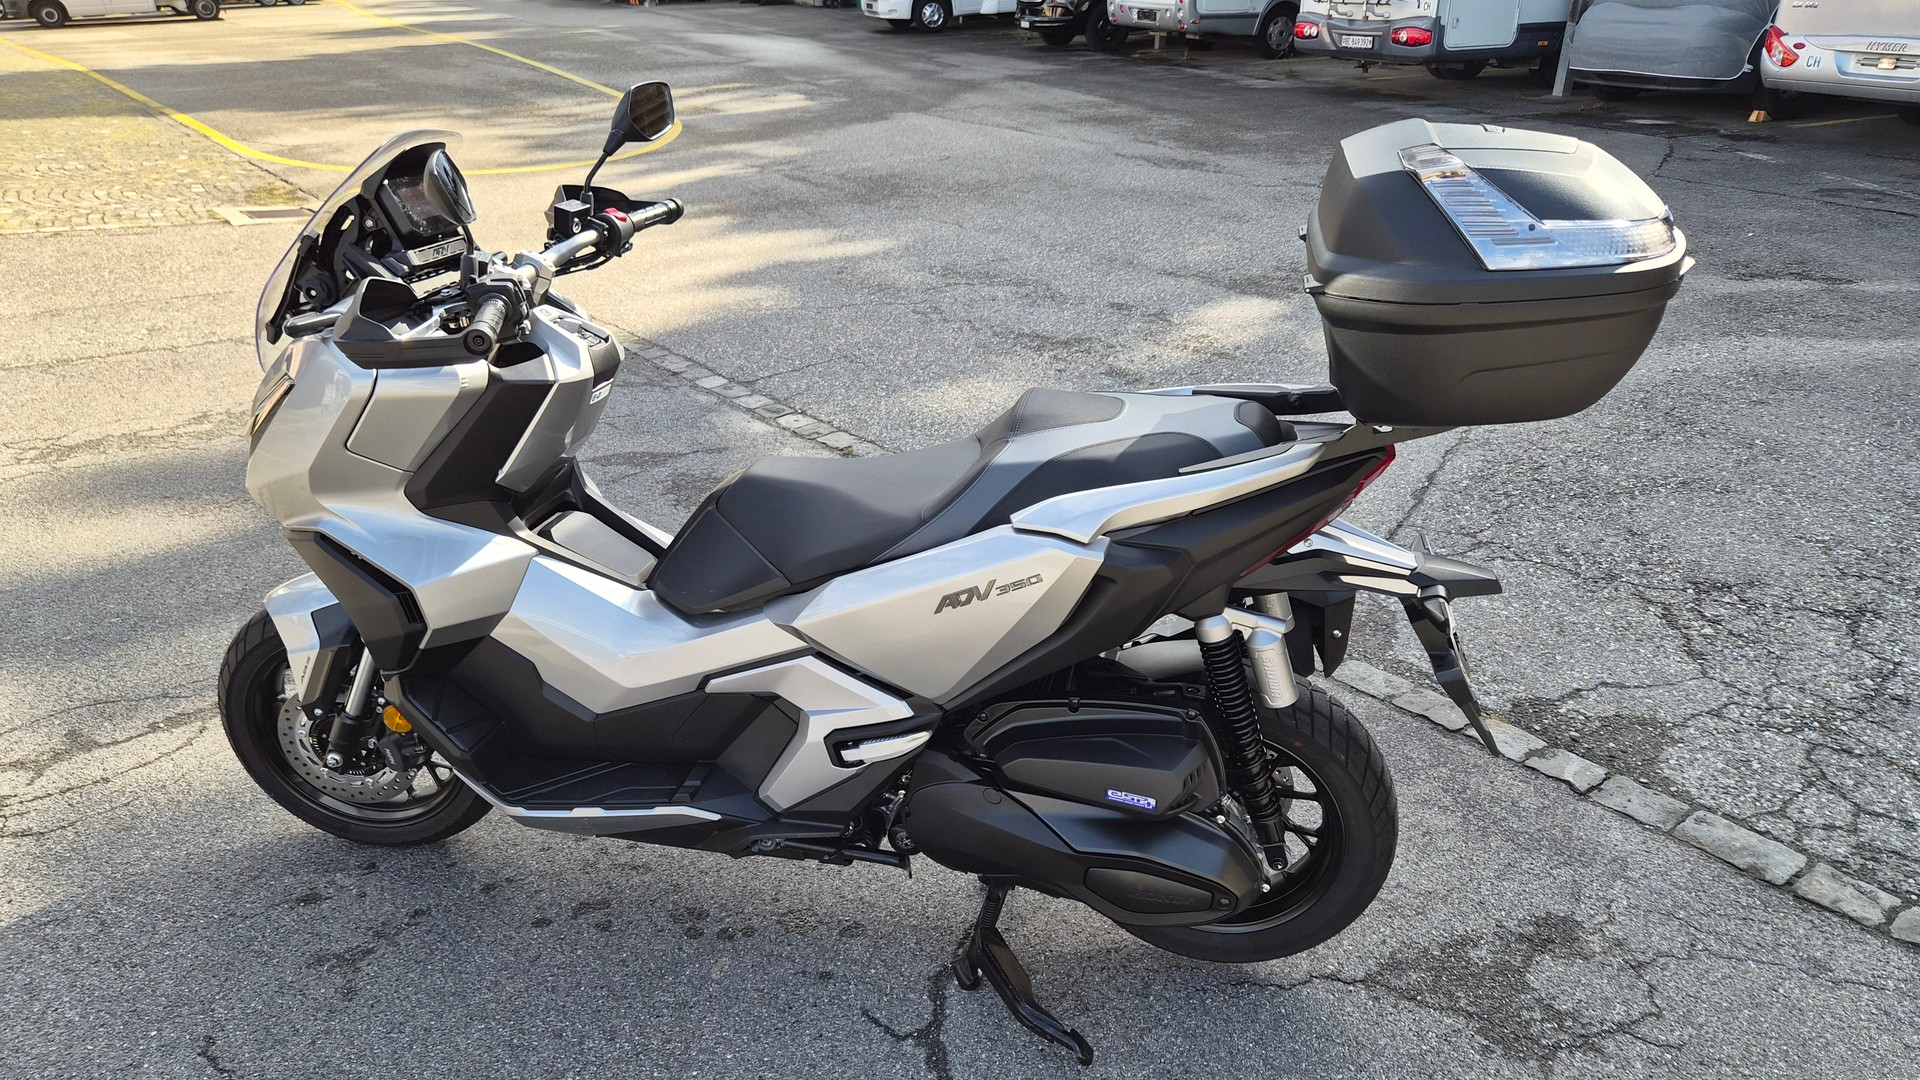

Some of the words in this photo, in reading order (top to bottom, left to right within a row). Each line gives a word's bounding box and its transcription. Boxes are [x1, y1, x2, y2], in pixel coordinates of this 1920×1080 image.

[1423, 2, 1431, 11] CH
[1866, 41, 1908, 53] HYMER
[1806, 56, 1822, 68] CH
[933, 579, 996, 615] ADV
[995, 573, 1044, 597] 350
